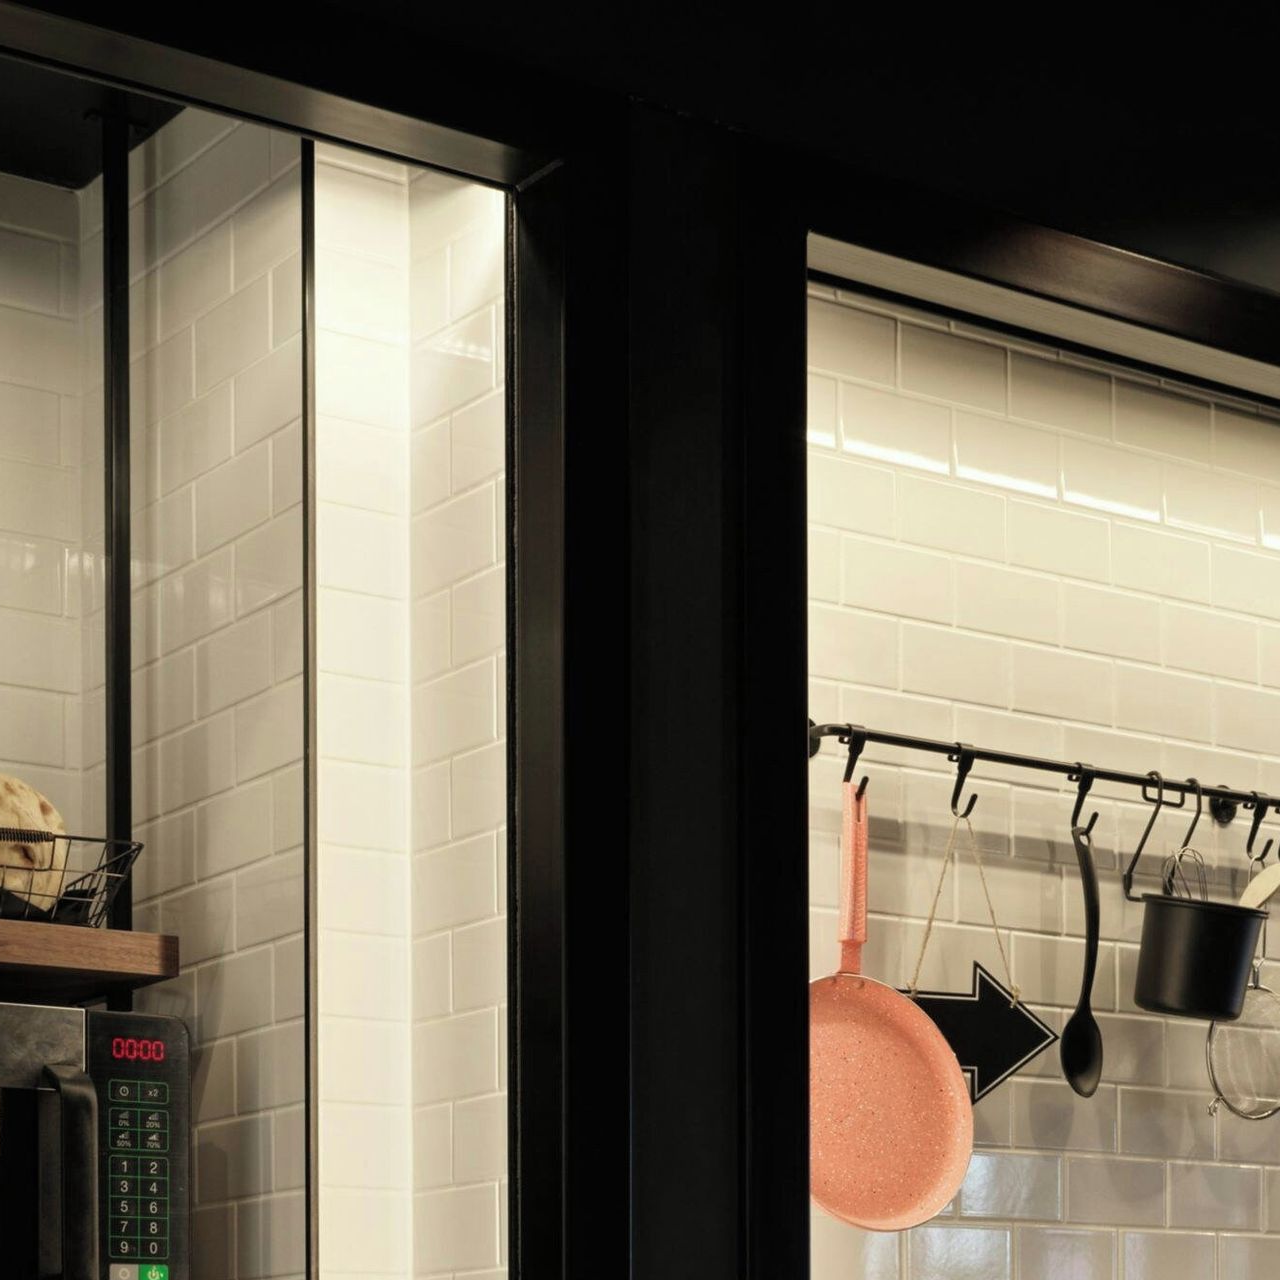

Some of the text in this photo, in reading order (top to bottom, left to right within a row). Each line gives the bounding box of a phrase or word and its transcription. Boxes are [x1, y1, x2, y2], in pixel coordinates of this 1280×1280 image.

[121, 1160, 128, 1173] 1
[149, 1161, 158, 1174] 2
[120, 1180, 129, 1193] 3
[149, 1182, 158, 1194] 4
[120, 1200, 129, 1213] 5
[149, 1201, 158, 1214] 6
[120, 1220, 129, 1233] 7
[149, 1221, 158, 1234] 8
[120, 1241, 129, 1254] 9
[149, 1242, 158, 1255] 0
